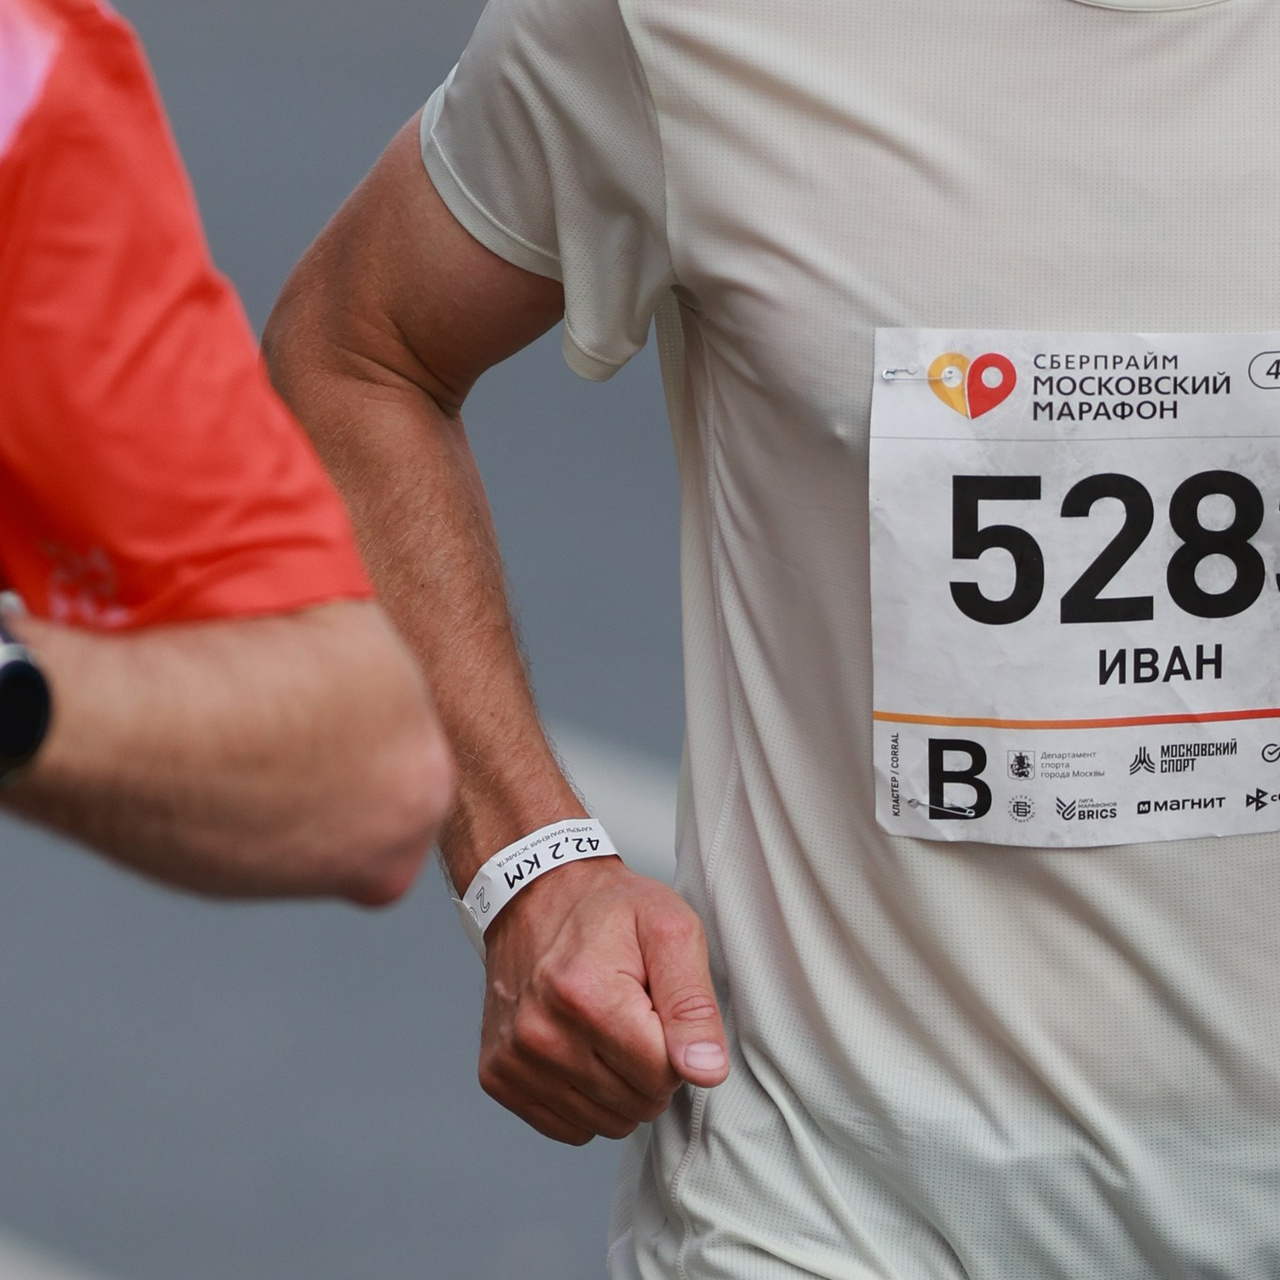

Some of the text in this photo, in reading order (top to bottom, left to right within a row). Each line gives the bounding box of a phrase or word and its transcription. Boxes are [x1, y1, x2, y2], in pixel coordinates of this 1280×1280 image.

[1033, 352, 1179, 371] СБЕРПРАЙМ
[1033, 371, 1231, 396] МОСКОВСКИЙ
[1033, 400, 1178, 421] МАРАФОН
[1098, 642, 1225, 687] ИВАН
[890, 732, 899, 769] CORRAL
[1040, 751, 1097, 761] Департамент
[1160, 738, 1238, 759] МОСКОВСКИЙ
[1040, 761, 1070, 771] спорта
[1040, 769, 1105, 780] города Москвы
[1160, 758, 1197, 773] СПОРТ
[891, 777, 900, 817] КЛАСТЕР
[1078, 808, 1117, 821] BRICS
[548, 836, 601, 860] 42,2
